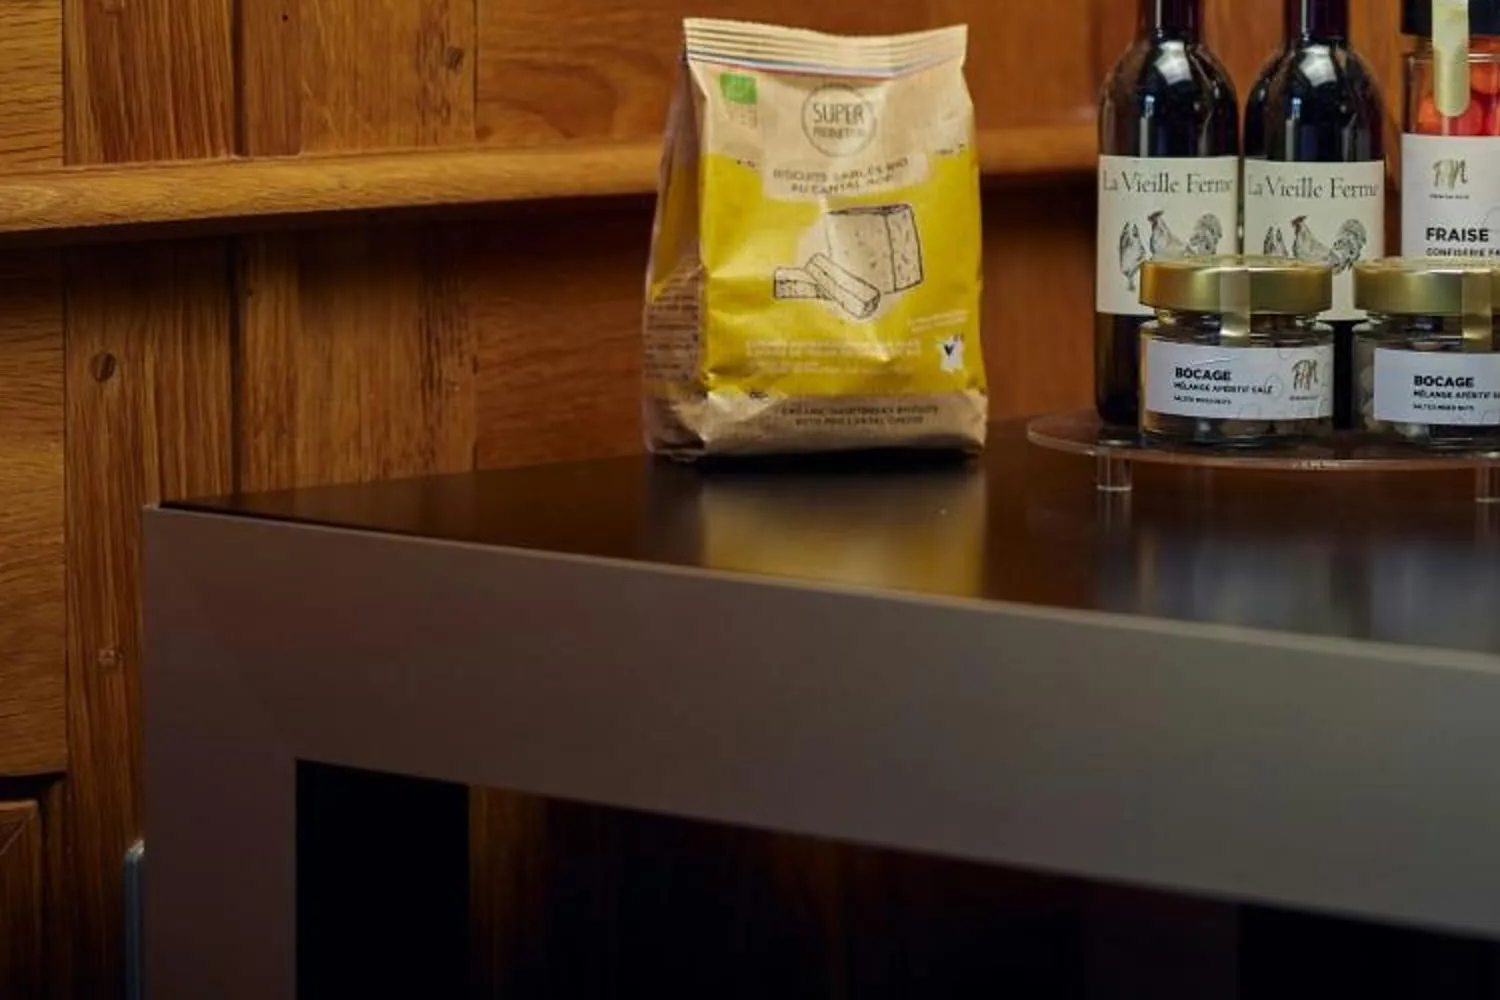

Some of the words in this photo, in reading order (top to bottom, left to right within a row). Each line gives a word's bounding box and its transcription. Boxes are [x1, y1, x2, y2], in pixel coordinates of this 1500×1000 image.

[813, 103, 865, 125] SUPER
[1121, 171, 1179, 193] Vieille
[1265, 175, 1323, 198] Vieille
[1426, 227, 1489, 242] FRAISE
[1426, 248, 1485, 257] CONFISERIE
[1175, 367, 1232, 381] BOCAGE
[1413, 375, 1475, 388] BOCAGE
